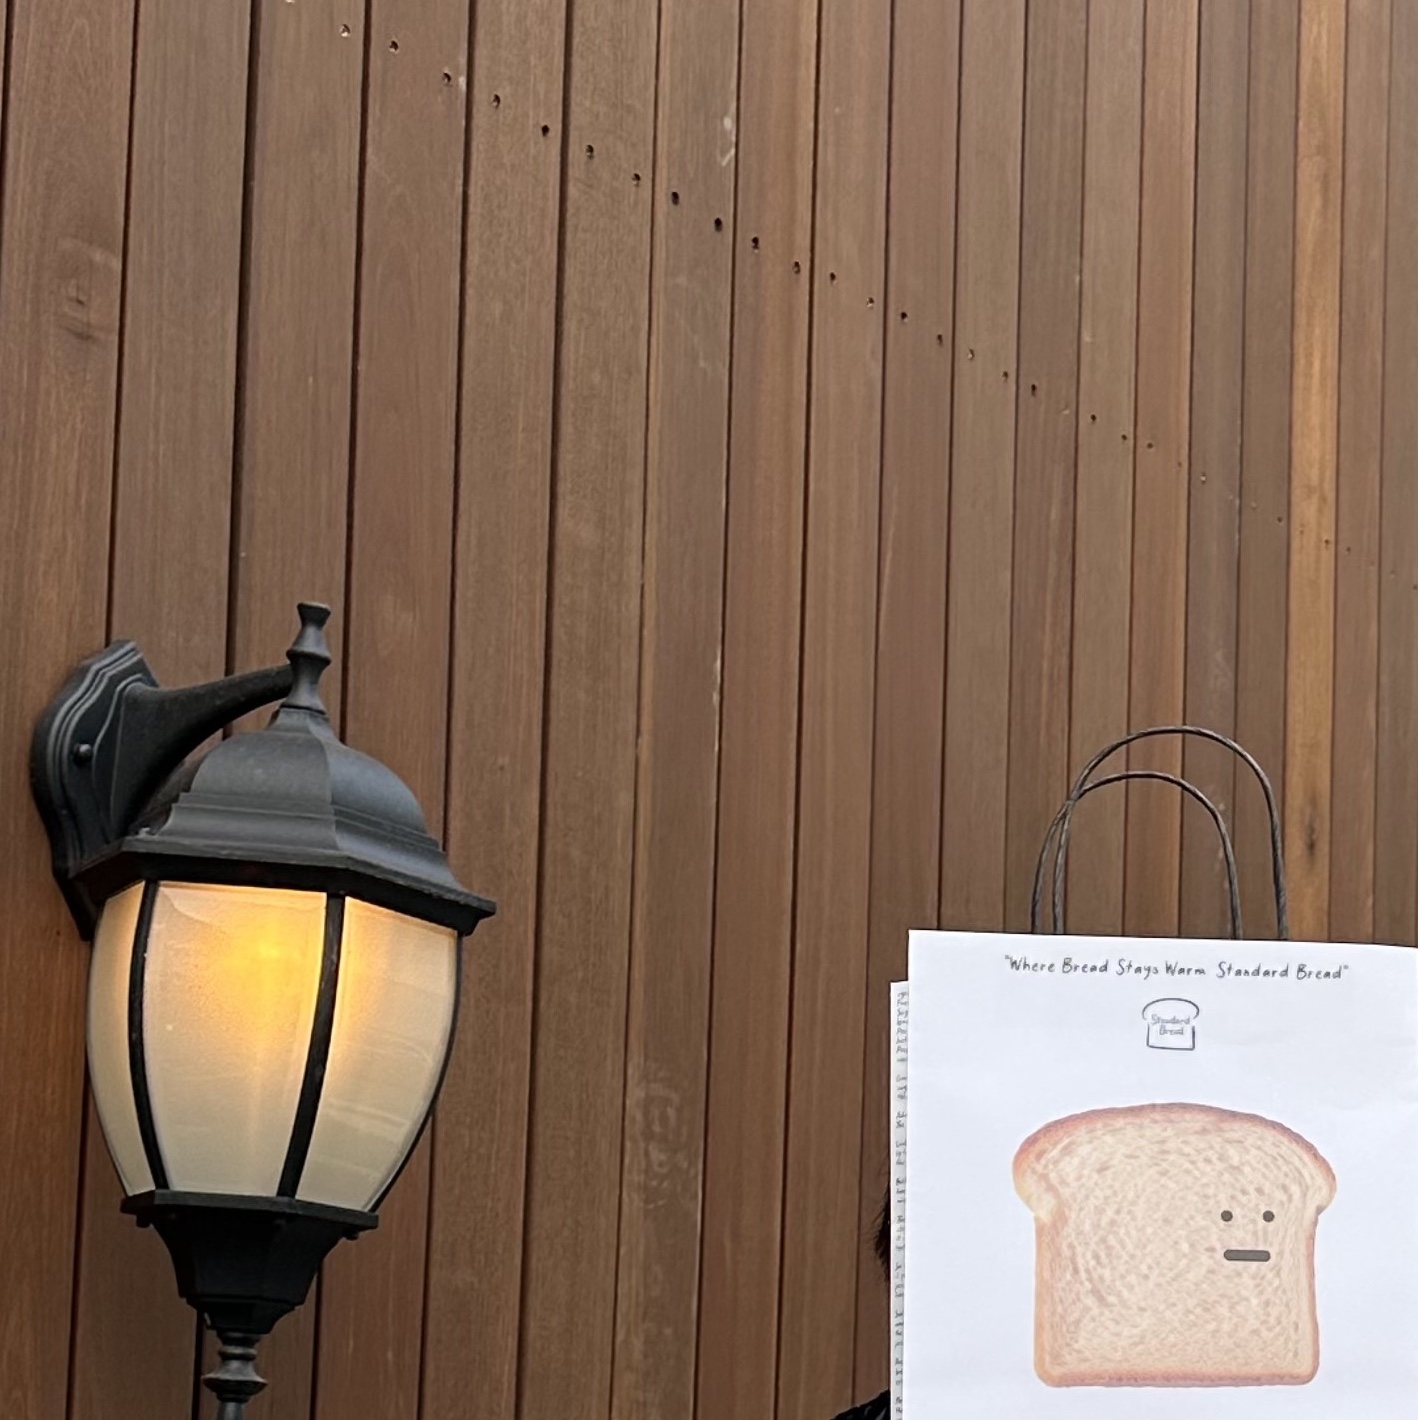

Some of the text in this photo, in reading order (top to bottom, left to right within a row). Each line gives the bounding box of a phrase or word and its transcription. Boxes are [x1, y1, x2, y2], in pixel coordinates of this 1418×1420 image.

[1061, 957, 1108, 974] Bread
[1115, 958, 1159, 980] Stays
[1165, 959, 1207, 977] Warm
[1215, 960, 1289, 979] Standard
[1159, 1024, 1185, 1036] Bread
